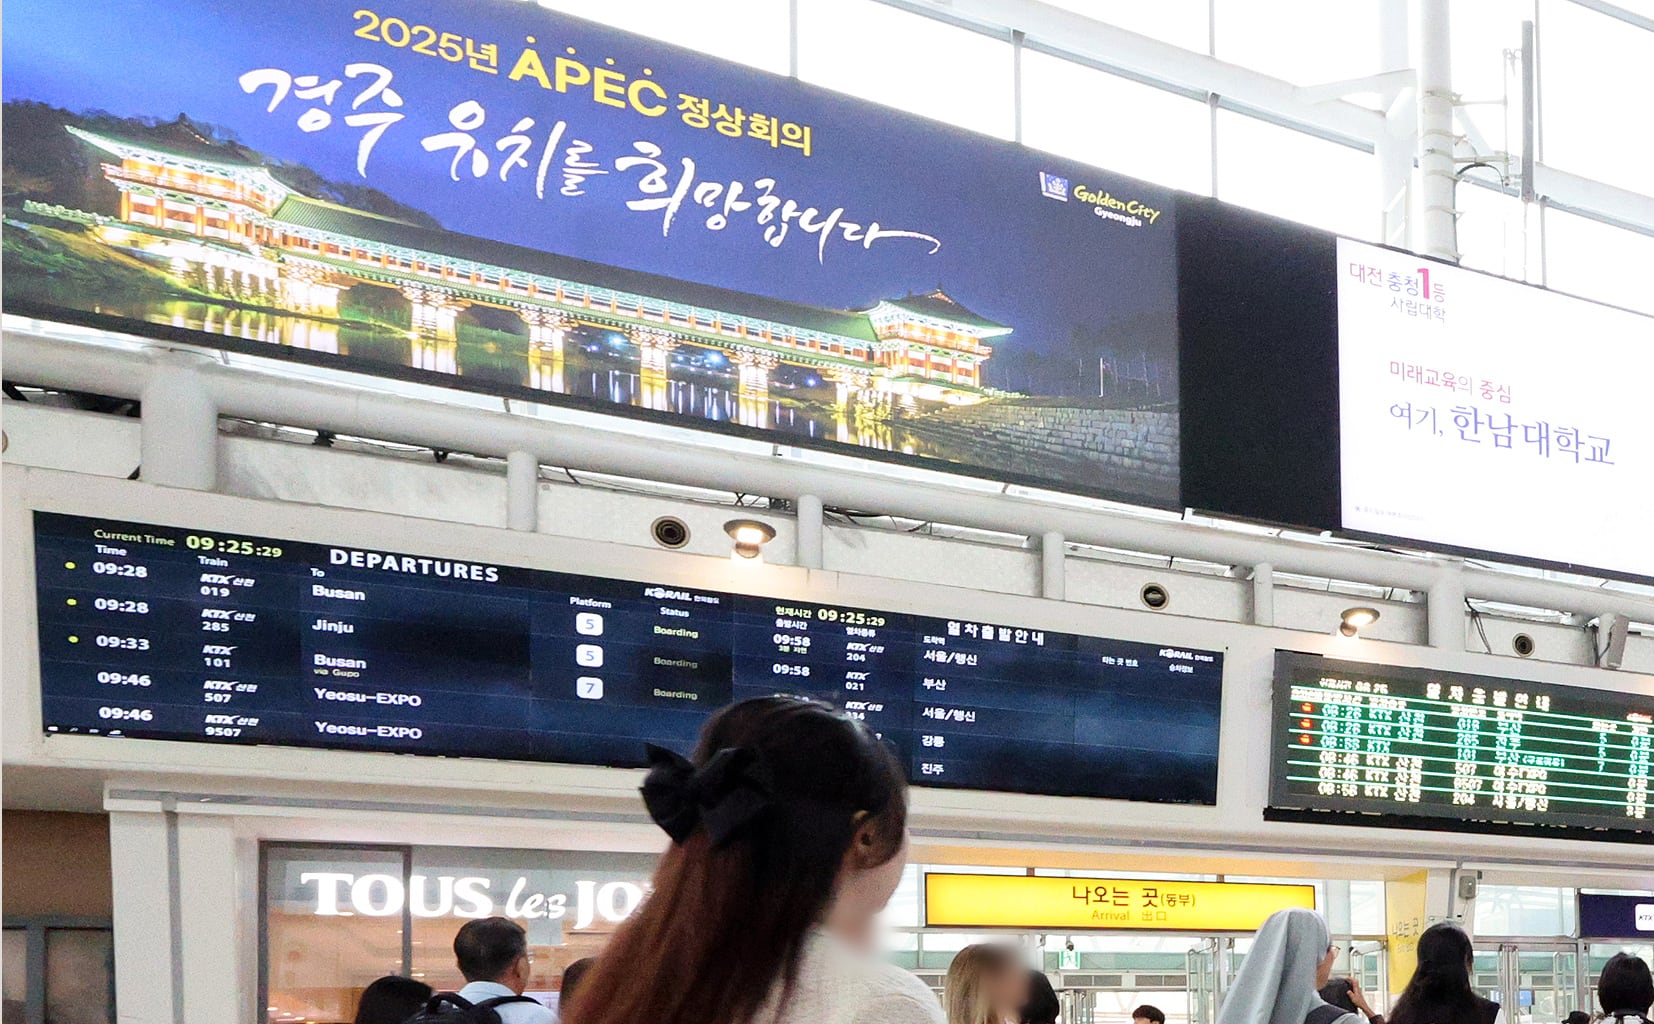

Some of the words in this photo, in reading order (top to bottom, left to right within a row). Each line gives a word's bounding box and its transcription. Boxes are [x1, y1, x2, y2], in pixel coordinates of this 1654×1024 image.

[353, 9, 499, 75] 2025년
[509, 36, 668, 117] APEC
[677, 92, 812, 156] 정상회의
[239, 62, 405, 178] 경주
[422, 101, 608, 199] 유치를
[615, 141, 941, 264] 희망합니다
[1074, 185, 1125, 211] Golden
[1127, 201, 1160, 224] City
[1094, 206, 1141, 226] Gyeongju
[1350, 263, 1382, 287] 대전
[1390, 296, 1447, 323] 사립대학
[1389, 360, 1473, 395] 미래교육의
[1480, 380, 1511, 404] 중심
[1389, 402, 1443, 436] 여기,
[1450, 405, 1616, 466] 한남대학교
[93, 529, 142, 543] Current
[144, 534, 176, 546] Time
[186, 535, 282, 557] 09:25:29
[95, 544, 127, 556] Time
[198, 555, 228, 567] Train
[310, 567, 325, 578] To
[330, 549, 499, 582] DEPARTURES
[93, 562, 148, 577] 09:28
[200, 573, 236, 584] KTX
[200, 586, 230, 597] 019
[312, 585, 366, 600] Busan
[644, 588, 692, 601] KORAIL
[94, 598, 149, 614] 09:28
[570, 596, 612, 609] Platform
[660, 607, 690, 618] Status
[201, 609, 237, 620] KTX
[775, 606, 812, 619] 현재시간
[818, 609, 885, 627] 09:25:29
[202, 621, 229, 632] 285
[312, 619, 354, 634] Jinju
[585, 618, 595, 630] 5
[654, 626, 699, 640] Boarding
[96, 635, 150, 650] 09:33
[773, 634, 811, 647] 09:58
[846, 642, 871, 652] KTX
[203, 645, 238, 655] KTX
[585, 650, 595, 662] 5
[1159, 649, 1193, 660] KORAIL
[204, 657, 230, 667] 101
[314, 654, 367, 669] Busan
[654, 657, 698, 669] Boarding
[846, 653, 866, 662] 204
[923, 650, 978, 667] 서울/행신
[313, 668, 328, 676] via
[332, 668, 360, 678] Gupo
[772, 664, 810, 677] 09:58
[846, 672, 870, 681] KTX
[97, 672, 152, 687] 09:46
[203, 680, 239, 690] KTX
[922, 678, 947, 691] 부산
[586, 682, 595, 694] 7
[845, 682, 864, 691] 021
[205, 692, 231, 703] 507
[314, 688, 422, 707] Yeosu-EXPO
[654, 688, 698, 701] Boarding
[845, 701, 870, 711] KTX
[98, 707, 153, 721] 09:46
[205, 715, 240, 725] KTX
[922, 707, 976, 723] 서울/행신
[205, 727, 241, 737] 9507
[314, 721, 423, 740] Yeosu-EXPO
[921, 735, 945, 748] 강릉
[921, 763, 945, 775] 진주
[300, 872, 492, 920] TOUS
[506, 876, 567, 919] les
[565, 879, 655, 930] JO
[1073, 886, 1129, 906] 나오는
[1092, 910, 1130, 921] Arrival
[1142, 911, 1167, 921] 出口
